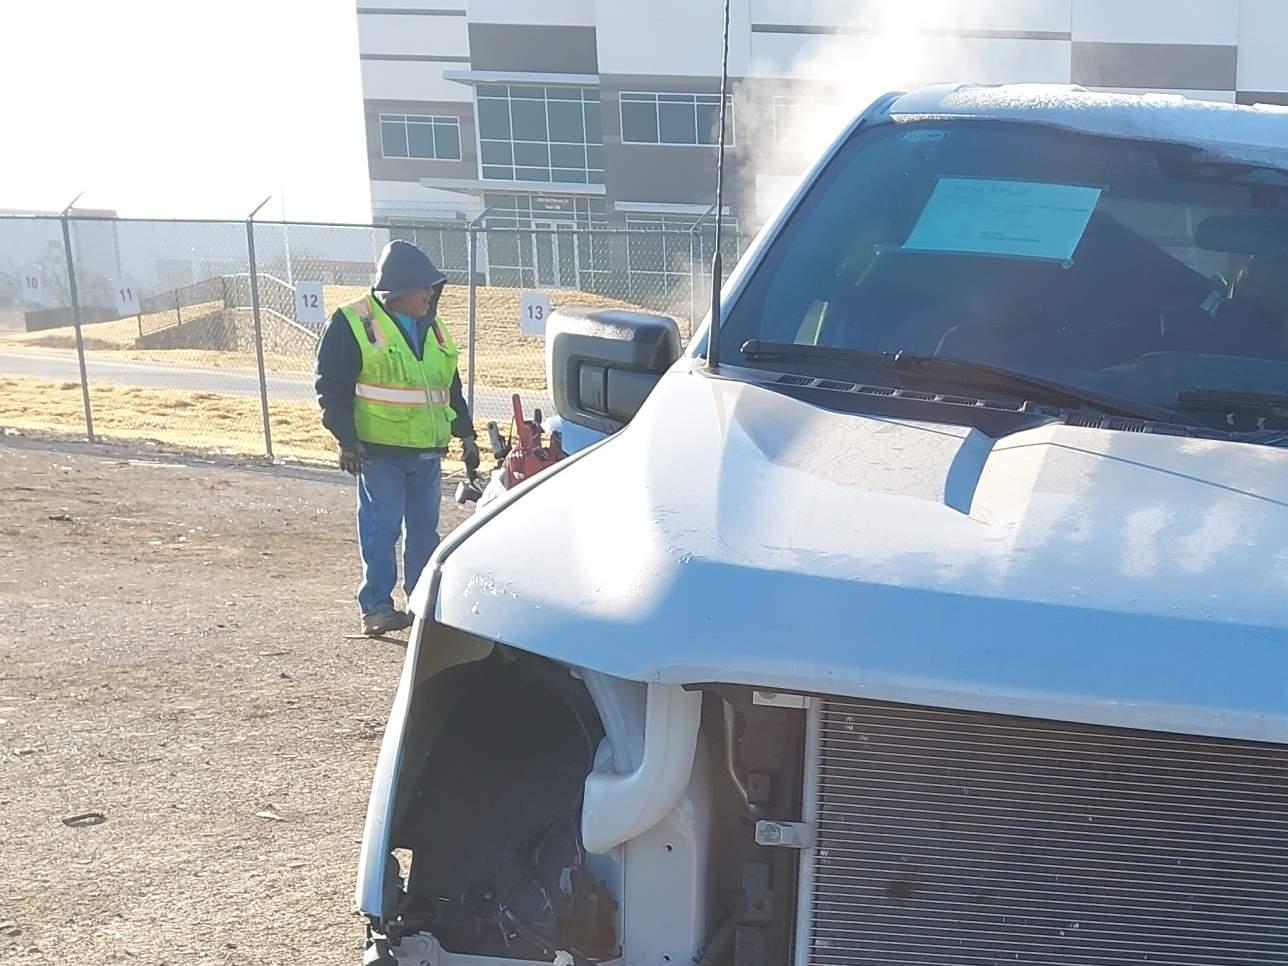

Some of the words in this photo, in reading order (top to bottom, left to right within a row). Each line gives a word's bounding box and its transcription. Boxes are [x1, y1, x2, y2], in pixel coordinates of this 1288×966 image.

[25, 276, 38, 290] 10
[119, 288, 132, 303] 11
[302, 293, 319, 309] 12
[527, 305, 544, 320] 13
